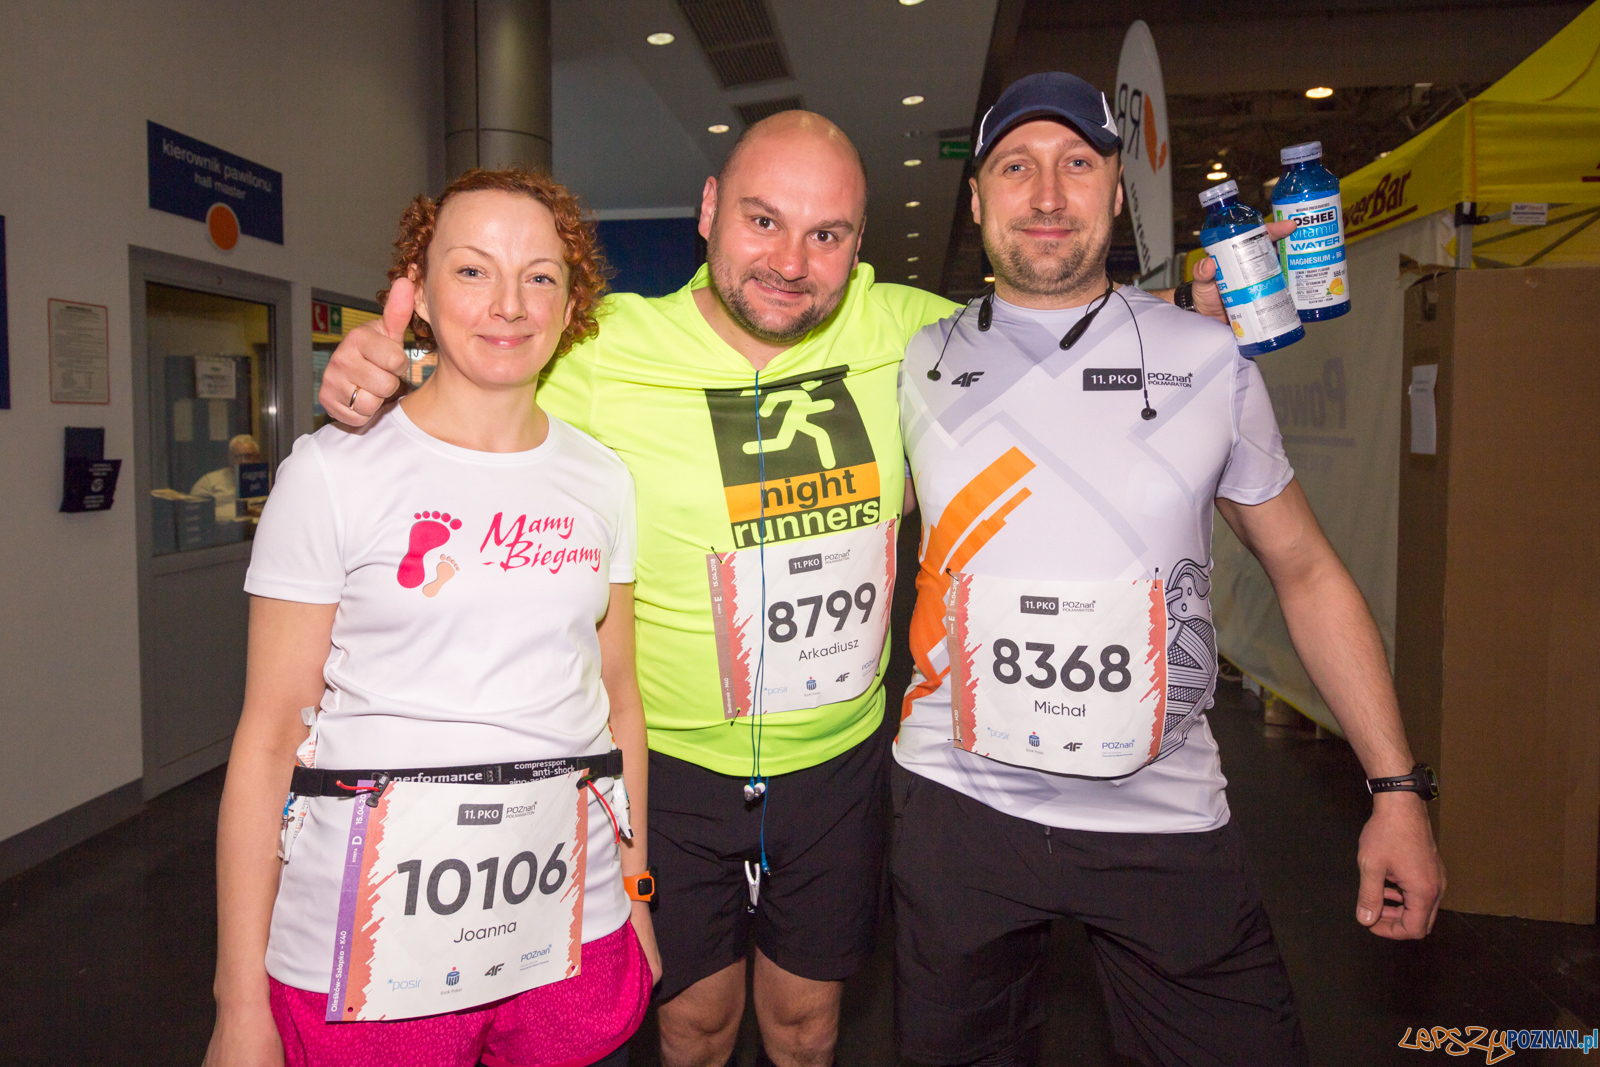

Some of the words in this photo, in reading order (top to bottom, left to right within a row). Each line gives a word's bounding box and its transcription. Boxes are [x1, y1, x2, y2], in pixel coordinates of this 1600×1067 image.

[162, 138, 221, 174] kierownik
[224, 165, 272, 192] pawilonu
[194, 172, 212, 188] hall
[214, 181, 246, 199] master
[1292, 222, 1338, 238] vitamin
[1290, 236, 1340, 251] WATER
[1290, 254, 1330, 266] MAGNESIUM
[951, 371, 984, 387] 4F
[1091, 374, 1106, 384] 11.
[1109, 374, 1137, 384] PKO
[762, 470, 856, 510] night
[733, 500, 880, 548] runners
[480, 512, 574, 553] Mamy
[792, 561, 802, 570] 11.
[803, 556, 820, 568] PKO
[768, 582, 876, 643] 8799
[1025, 600, 1035, 609] 11.
[1036, 602, 1056, 610] PKO
[798, 640, 859, 661] Arkadiusz
[992, 638, 1132, 693] 8368
[835, 672, 850, 682] 4F
[1034, 700, 1086, 717] Michał
[1063, 742, 1083, 752] 4F
[514, 760, 566, 770] compressport
[532, 765, 575, 777] anti-shock
[393, 772, 483, 783] performance
[464, 810, 476, 819] 11.
[478, 809, 499, 819] PKO
[352, 835, 362, 845] D
[397, 842, 567, 916] 10106
[454, 921, 517, 944] Joanna
[485, 963, 505, 977] 4F
[392, 978, 422, 992] posir
